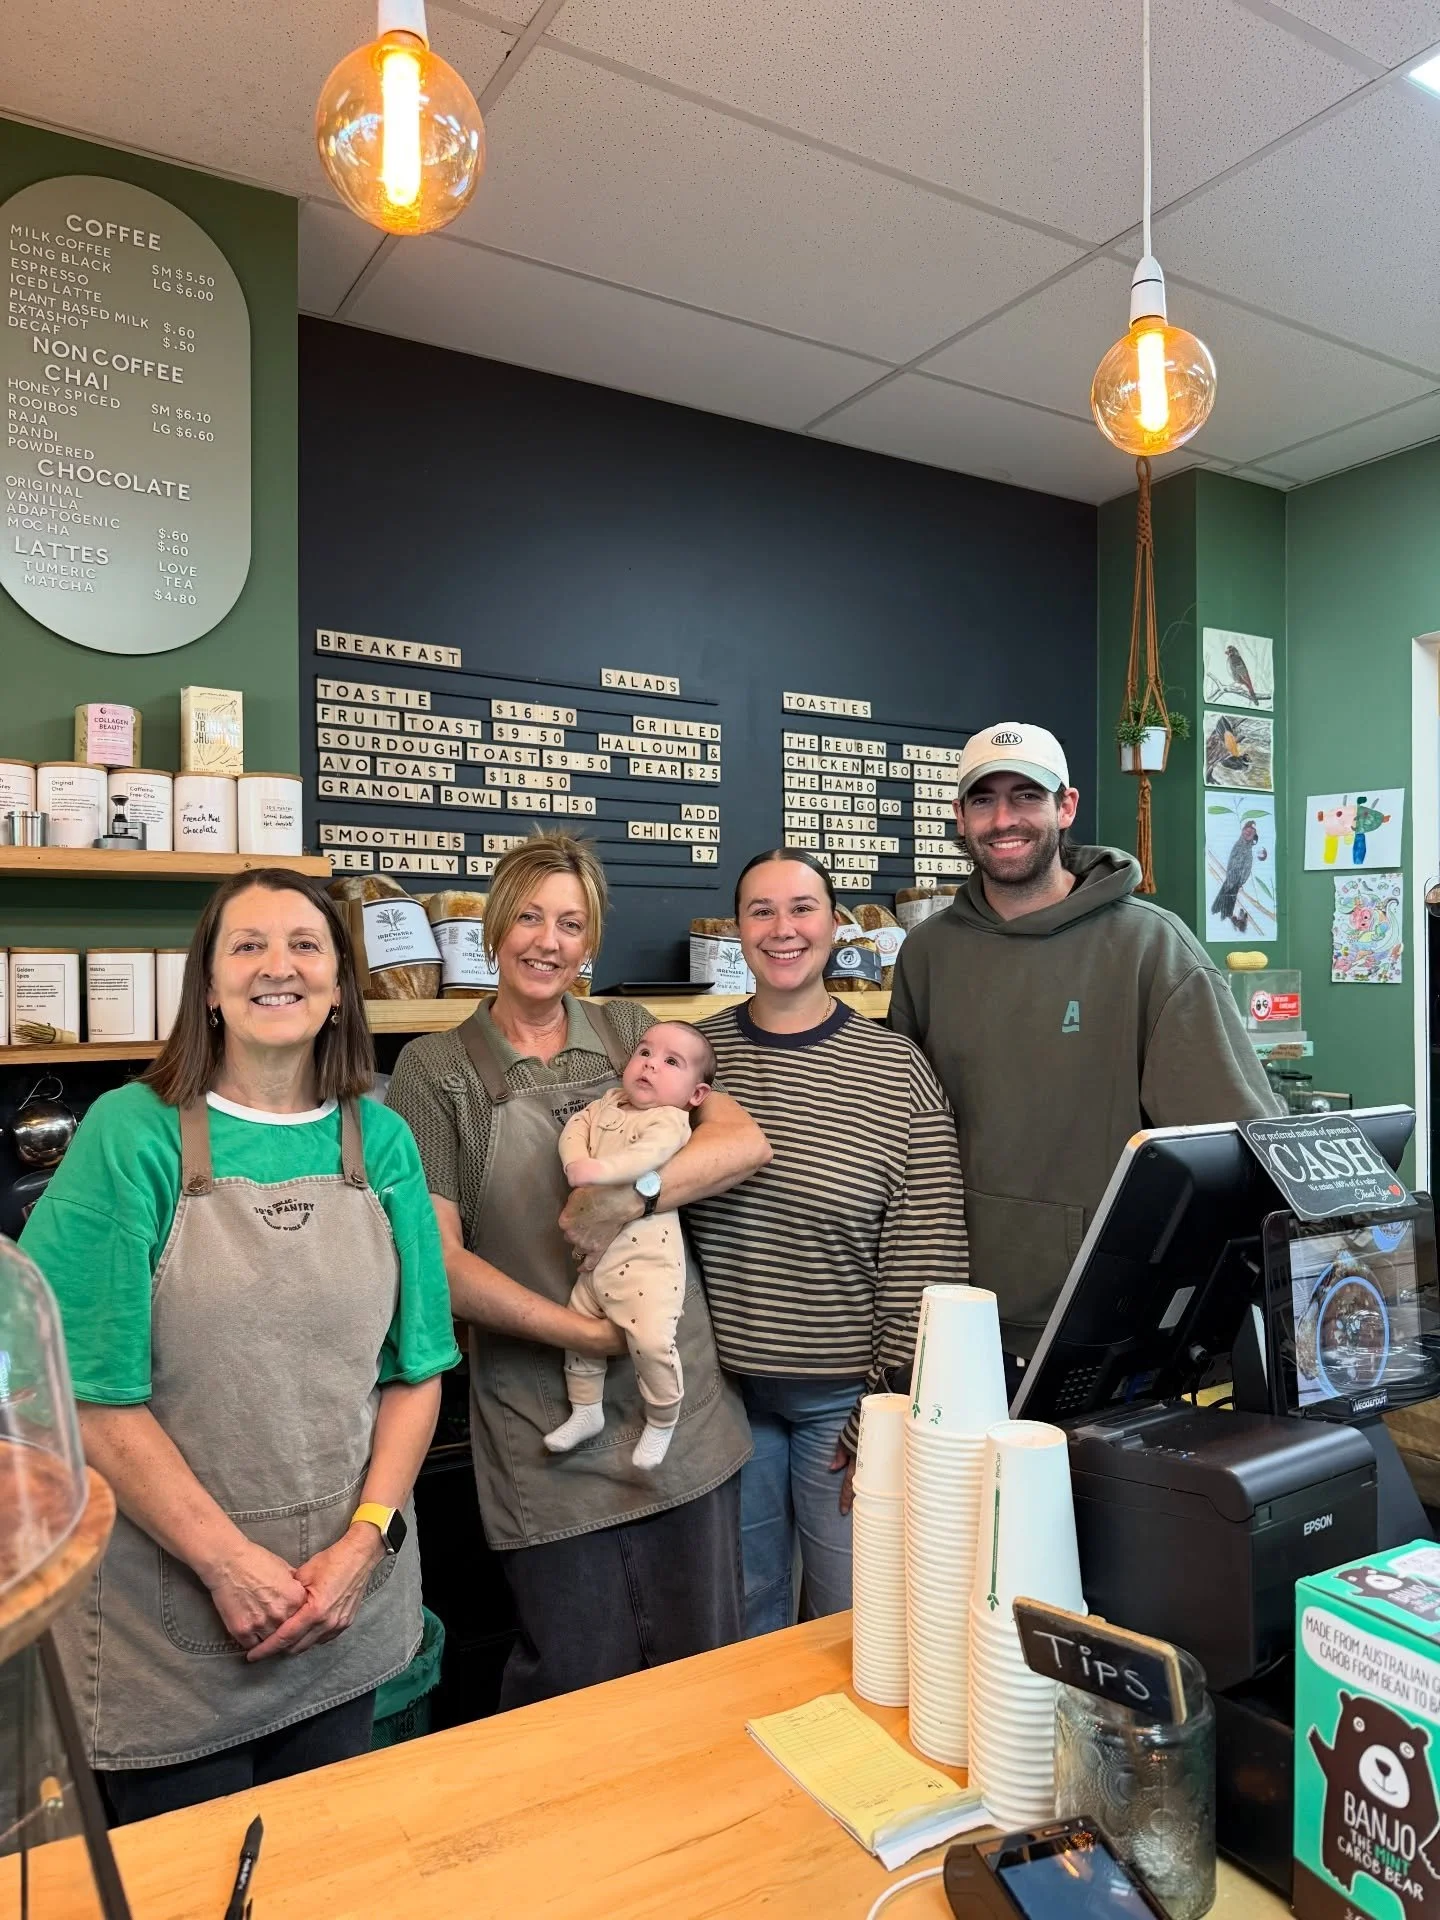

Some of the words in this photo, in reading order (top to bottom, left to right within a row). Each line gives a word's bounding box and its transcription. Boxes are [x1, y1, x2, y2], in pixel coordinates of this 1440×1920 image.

[10, 224, 51, 243] MILK
[55, 235, 112, 258] COFFEE
[66, 214, 162, 251] COFFEE
[10, 240, 56, 260] LONG
[61, 252, 112, 273] BLACK
[11, 258, 89, 285] ESPRESSO
[151, 264, 172, 279] SM
[175, 269, 215, 287] $5.50
[10, 273, 49, 290] ICED
[53, 283, 103, 303] LATTE
[153, 279, 172, 292] LG
[176, 283, 214, 302] $6.00
[9, 288, 57, 308] PLANT
[62, 300, 110, 320] BASED
[115, 312, 150, 329] MILK
[9, 302, 89, 330] EXTASHOT
[8, 316, 61, 334] DECAF
[163, 322, 195, 339] $.60
[162, 337, 195, 353] $.50
[44, 364, 109, 391] CHAI
[8, 378, 61, 397] HONEY
[64, 388, 121, 409] SPICED
[8, 392, 78, 416] ROOIBOS
[151, 404, 170, 416] SM
[176, 407, 211, 424] $6.10
[8, 409, 48, 426] RAJA
[8, 423, 59, 441] DANDI
[152, 422, 171, 435] LG
[176, 425, 214, 442] $6.60
[8, 437, 95, 460] POWDERED
[6, 475, 84, 499] ORIGINAL
[37, 458, 191, 501] CHOCOLATE
[6, 489, 79, 511] VANILLA
[6, 503, 120, 529] ADAPTOGENIC
[7, 517, 70, 536] MOCHA
[158, 528, 189, 543] $.60
[15, 535, 109, 565] LATTES
[24, 561, 97, 579] TUMERIC
[159, 561, 197, 577] LOVE
[24, 575, 94, 593] MATCHA
[163, 576, 193, 590] TEA
[154, 590, 197, 605] $4.80
[320, 634, 459, 665] BREAKFAST
[604, 672, 677, 692] SALADS
[320, 683, 428, 708] TOASTIE
[786, 696, 869, 715] TOASTIES
[94, 717, 128, 726] COLLAGEN
[322, 708, 397, 728] FRUIT
[409, 717, 480, 737] TOAST
[635, 719, 720, 739] GRILLED
[322, 732, 461, 758] SOURDOUGH
[470, 747, 537, 763] TOAST
[601, 736, 698, 757] HALLOUMI
[710, 748, 718, 759] &
[786, 736, 816, 749] THE
[824, 739, 885, 755] REUBEN
[323, 755, 369, 771] AVO
[381, 762, 451, 778] TOAST
[633, 761, 678, 776] PEAR
[687, 766, 718, 779] $25
[787, 756, 860, 772] CHICKEN
[866, 763, 884, 774] ME
[892, 766, 909, 776] SO
[322, 780, 431, 800] GRANOLA
[445, 790, 497, 806] BOWL
[787, 776, 817, 789] THE
[824, 779, 875, 792] HAMBO
[684, 807, 718, 821] ADD
[788, 796, 849, 810] VEGGIE
[857, 801, 875, 811] GO
[882, 803, 900, 813] GO
[183, 814, 207, 822] French
[787, 816, 817, 828] THE
[827, 818, 876, 830] BASIC
[917, 823, 943, 834] $12
[183, 825, 218, 835] Chocolate
[324, 828, 462, 849] SMOOTHIES
[632, 824, 718, 840] CHICKEN
[788, 835, 817, 847] THE
[828, 838, 897, 851] BRISKET
[327, 853, 370, 867] SEE
[382, 855, 455, 870] DAILY
[696, 848, 715, 861] $7
[836, 858, 877, 869] MELT
[1253, 1132, 1267, 1142] Our
[1267, 1130, 1296, 1142] preferred
[1295, 1128, 1319, 1138] method
[1319, 1127, 1326, 1136] of
[1326, 1126, 1351, 1138] payment
[1349, 1125, 1358, 1133] is
[1268, 1138, 1385, 1183] CASH
[276, 1203, 315, 1214] PANTRY
[1304, 1514, 1333, 1537] EPSON
[1306, 1616, 1333, 1642] MADE
[1334, 1630, 1360, 1654] FROM
[1362, 1644, 1429, 1689] AUSTRALIAN
[1320, 1642, 1351, 1672] CAROB
[1352, 1659, 1379, 1686] FROM
[1382, 1674, 1410, 1700] BEAN
[1415, 1688, 1427, 1709] TO
[1344, 1790, 1416, 1861] BANJO
[1350, 1828, 1373, 1855] THE
[1375, 1844, 1411, 1877] MINT
[1337, 1836, 1381, 1874] CAROB
[1385, 1867, 1424, 1902] BEAR
